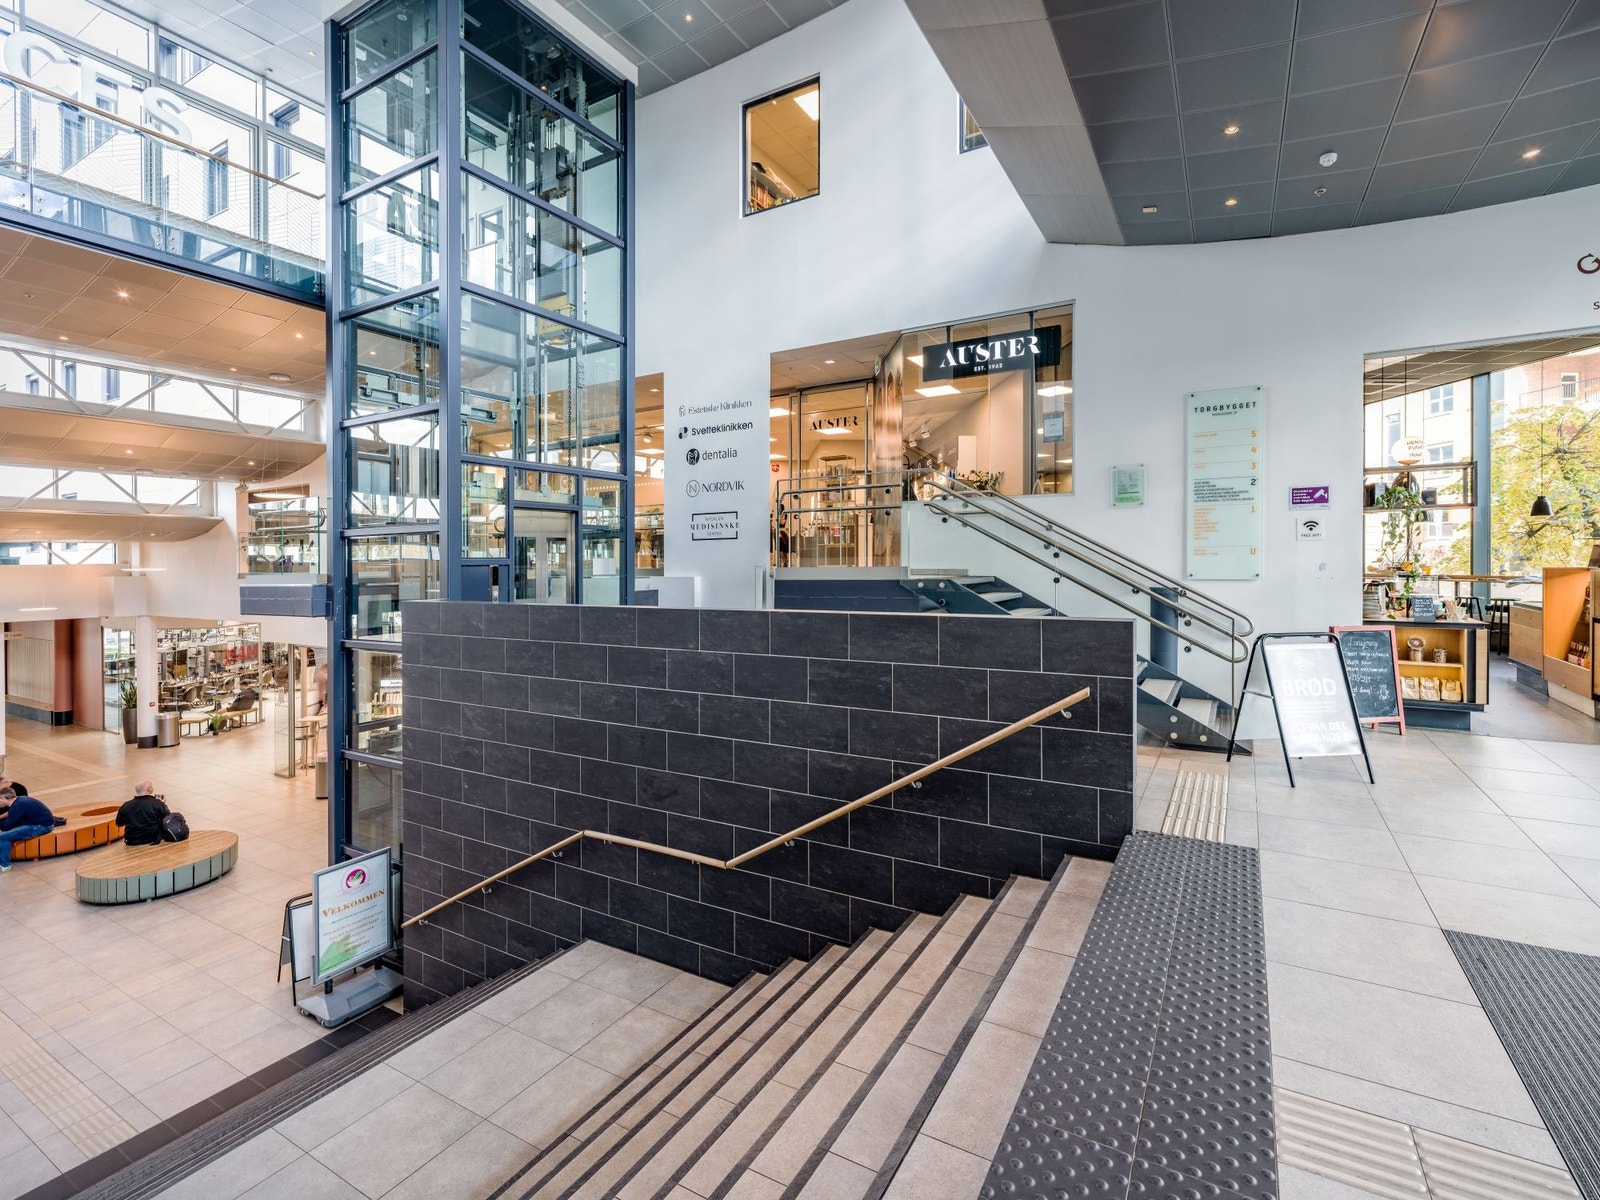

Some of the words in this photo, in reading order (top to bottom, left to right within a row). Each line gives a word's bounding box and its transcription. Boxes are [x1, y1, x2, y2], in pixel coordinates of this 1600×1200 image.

[939, 336, 1041, 368] AUSTER
[1194, 401, 1257, 413] TORGBYGGET
[810, 415, 858, 431] AUSTER
[1251, 429, 1257, 438] 5
[702, 448, 738, 461] dentalia
[1250, 461, 1257, 470] 3
[702, 481, 745, 493] NORDVIK
[1250, 478, 1257, 486] 2
[1250, 505, 1256, 513] 1
[690, 521, 741, 530] MEDISINSKE
[1281, 675, 1337, 699] BRØD
